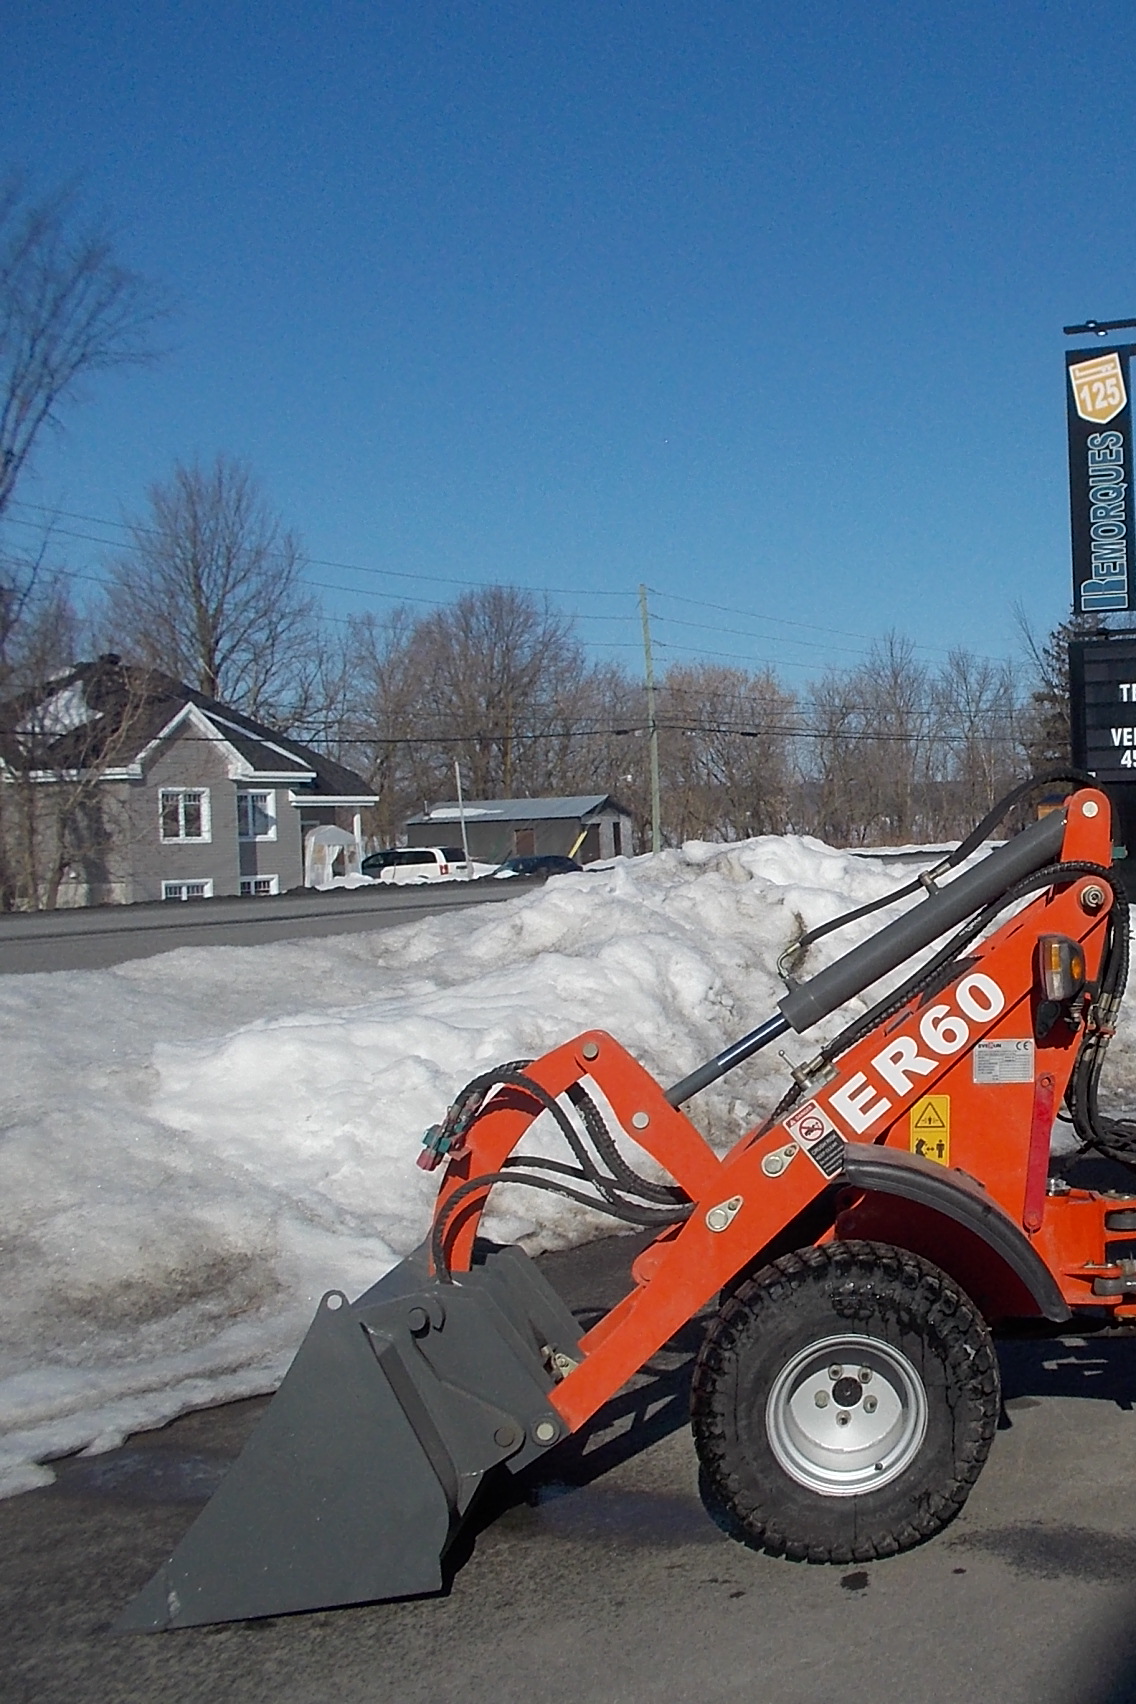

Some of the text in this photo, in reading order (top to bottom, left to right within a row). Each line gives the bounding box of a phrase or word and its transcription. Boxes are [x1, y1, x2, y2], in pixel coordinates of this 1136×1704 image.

[1080, 377, 1120, 412] 125
[1081, 431, 1128, 611] REMORQUES
[828, 973, 1005, 1135] ER60
